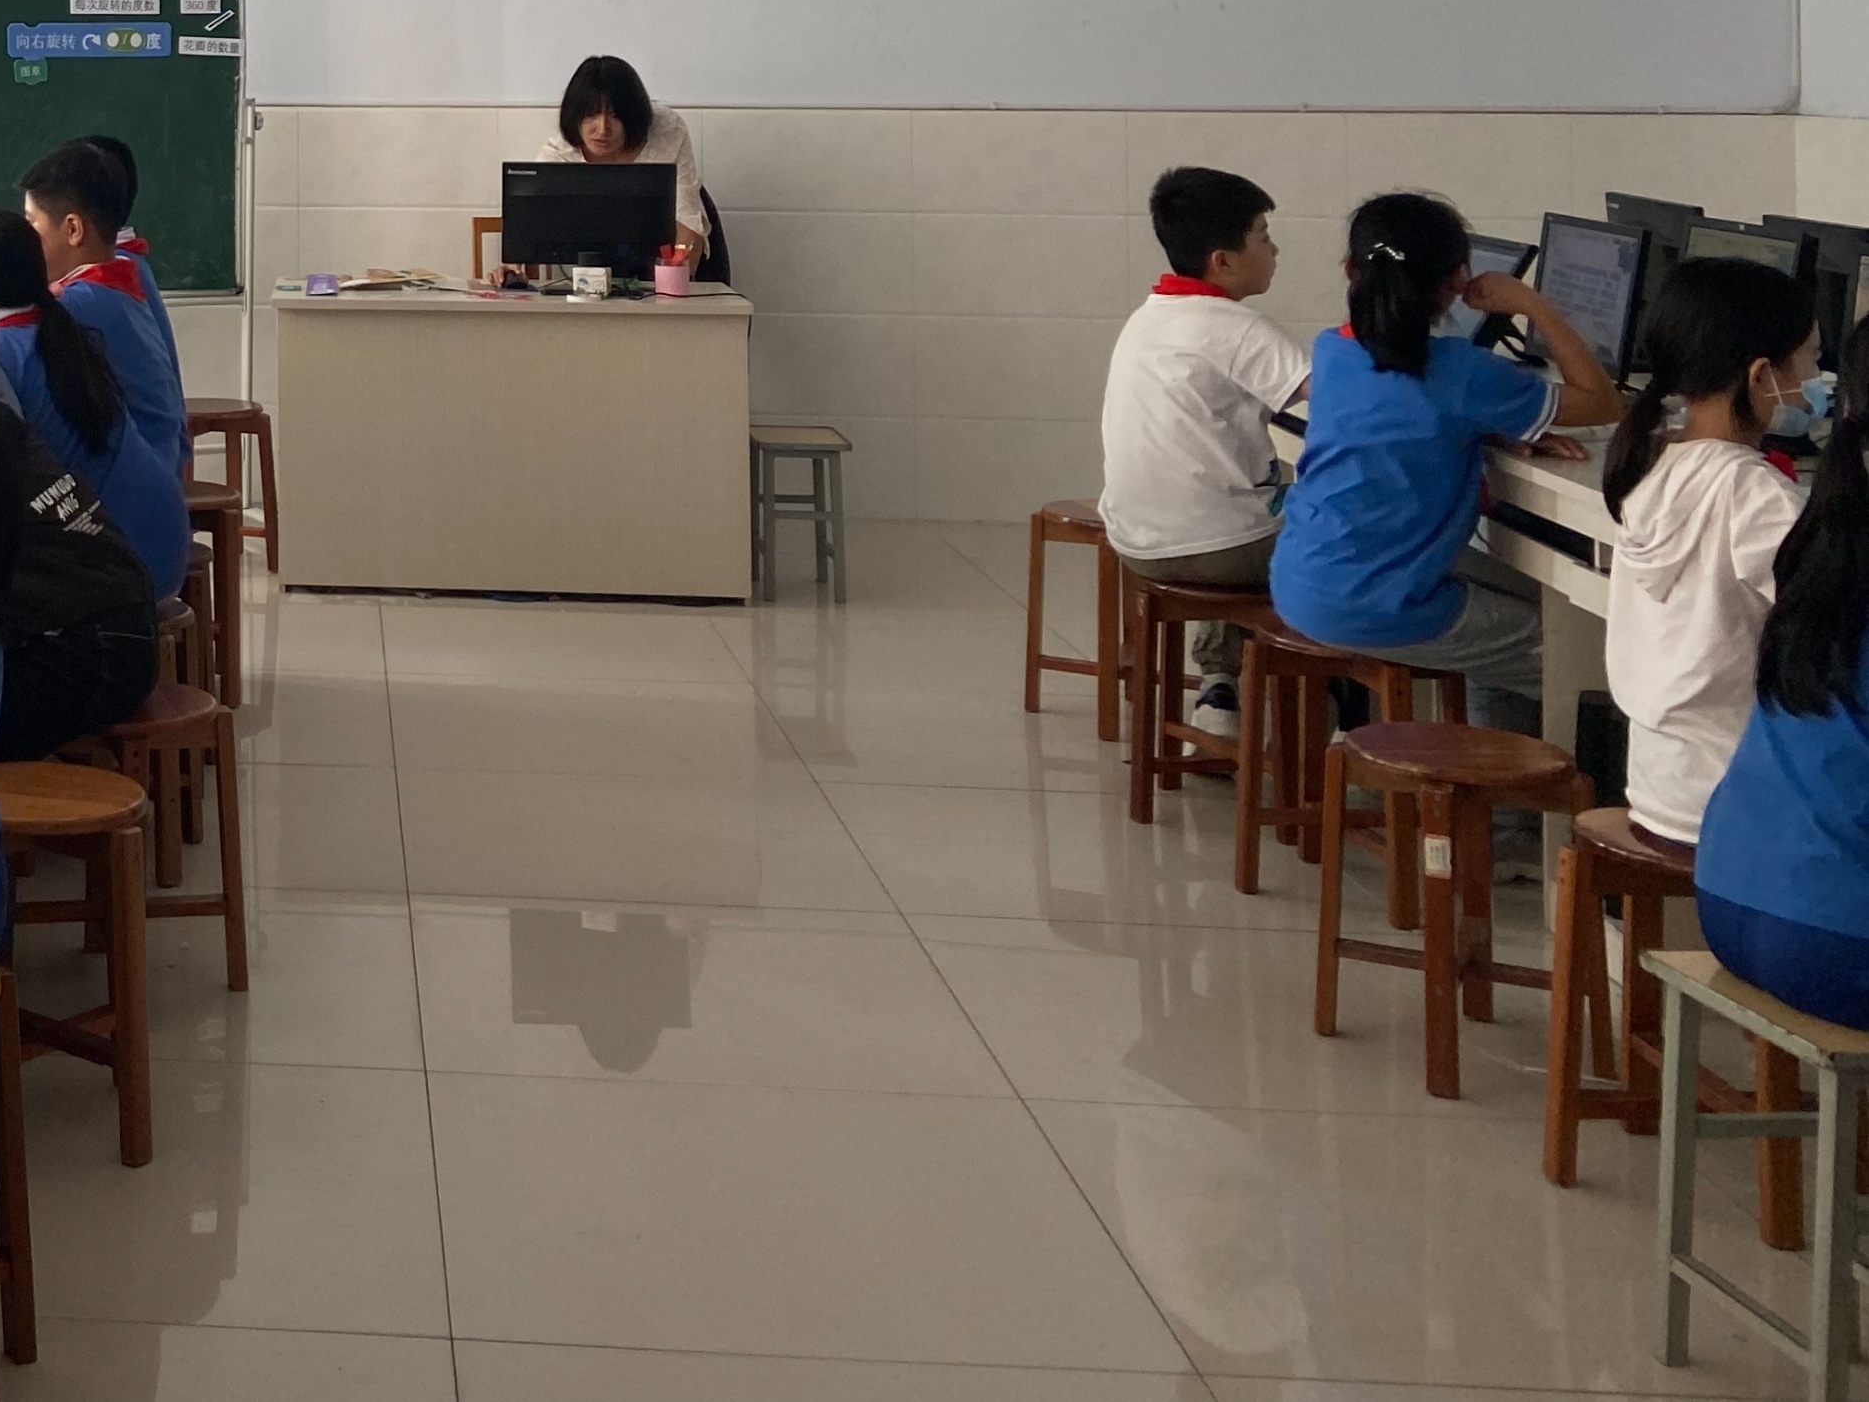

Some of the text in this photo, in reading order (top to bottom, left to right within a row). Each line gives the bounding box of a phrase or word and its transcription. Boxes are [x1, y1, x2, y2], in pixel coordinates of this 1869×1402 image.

[185, 0, 218, 12] 360 度
[15, 33, 163, 50] 向右旋转 度
[183, 39, 240, 54] 花瓣的数量
